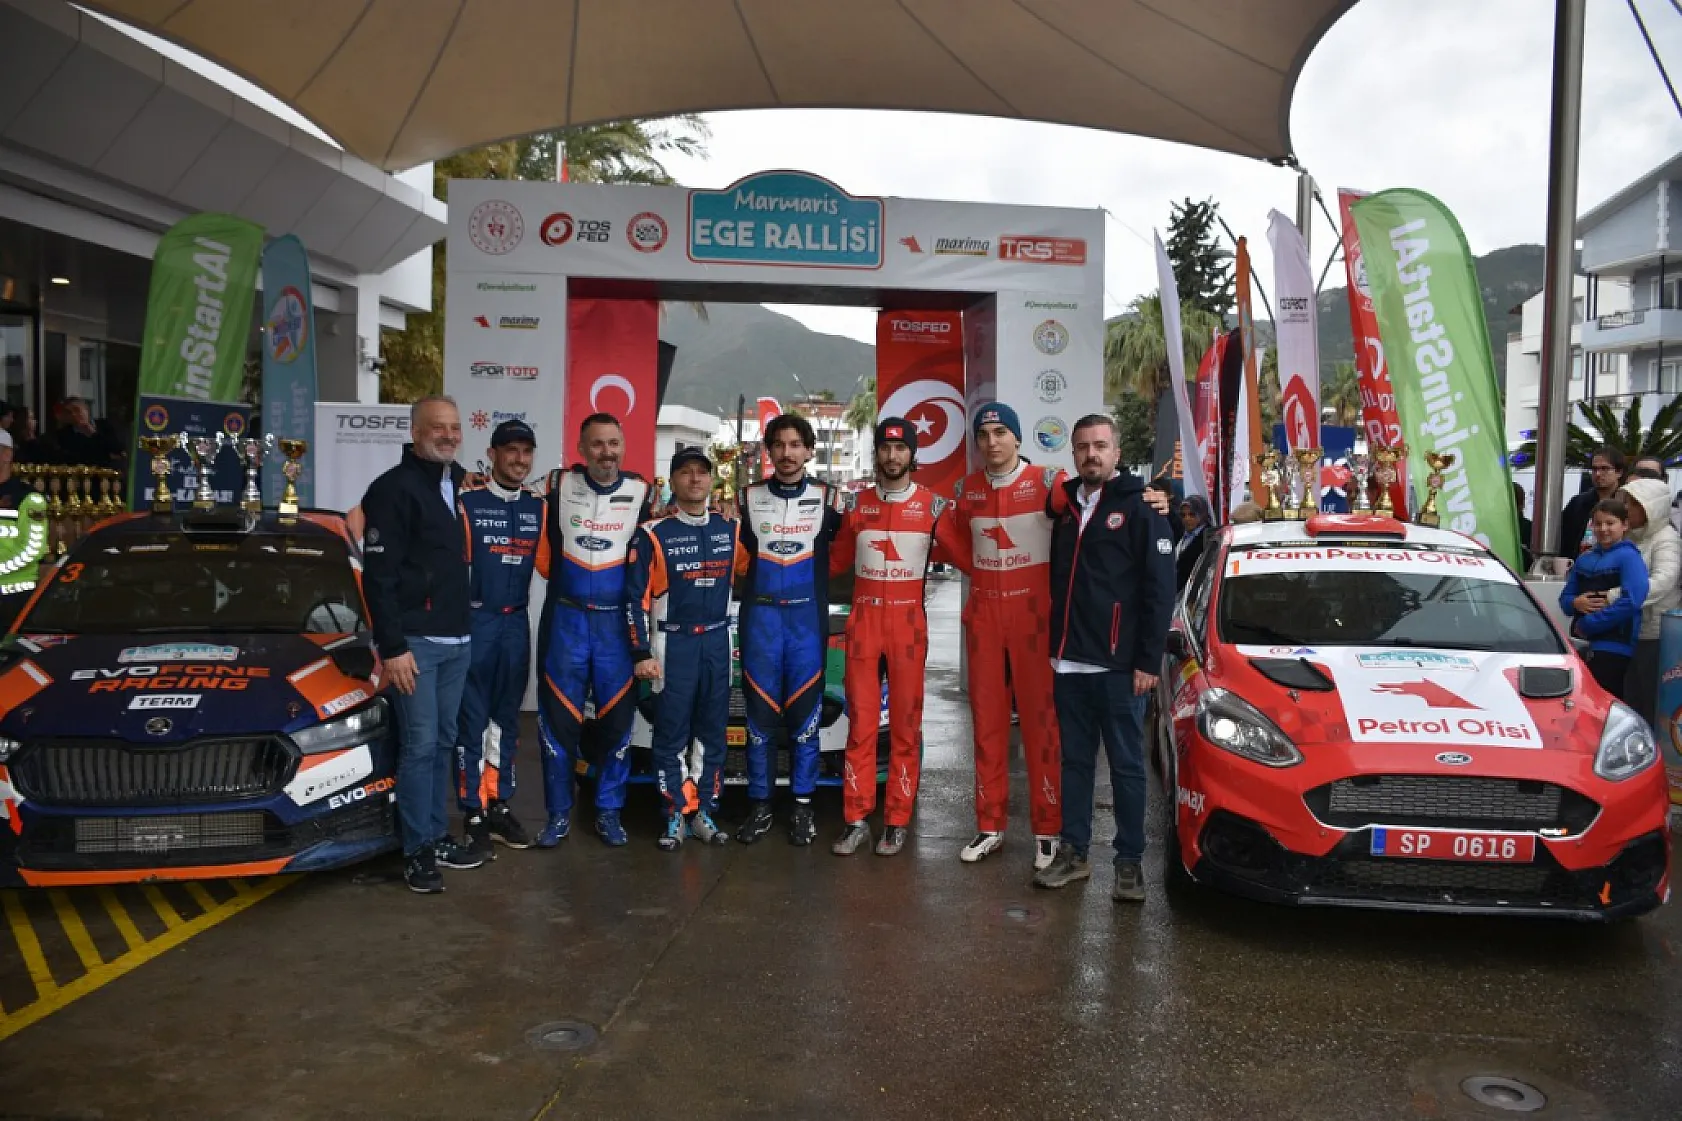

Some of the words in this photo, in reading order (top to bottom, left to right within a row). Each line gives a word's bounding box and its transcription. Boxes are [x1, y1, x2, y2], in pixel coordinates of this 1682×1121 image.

[733, 189, 839, 215] Marmaris
[578, 220, 611, 231] TOS
[576, 231, 609, 243] FED
[694, 218, 756, 248] EGE
[764, 218, 876, 253] RALLİSİ
[936, 236, 990, 251] maxima
[1001, 239, 1053, 259] TRS
[890, 319, 951, 333] TOSFED
[336, 414, 410, 430] TOSFE
[583, 519, 624, 531] Castrol
[773, 523, 813, 534] Castrol
[977, 554, 1003, 567] Petrol
[1005, 552, 1032, 566] Ofisi
[1245, 549, 1322, 560] Team
[1327, 548, 1413, 561] Petrol
[1417, 550, 1487, 568] Ofisi
[60, 562, 85, 583] 3
[861, 564, 888, 577] Petrol
[890, 566, 914, 578] Ofisi
[1231, 559, 1240, 575] 1
[70, 664, 271, 681] EVOFONE
[88, 677, 250, 694] RACING
[1357, 718, 1450, 735] Petrol
[1457, 719, 1532, 741] Ofisi
[1400, 832, 1431, 854] SP
[1454, 836, 1516, 859] 0616
